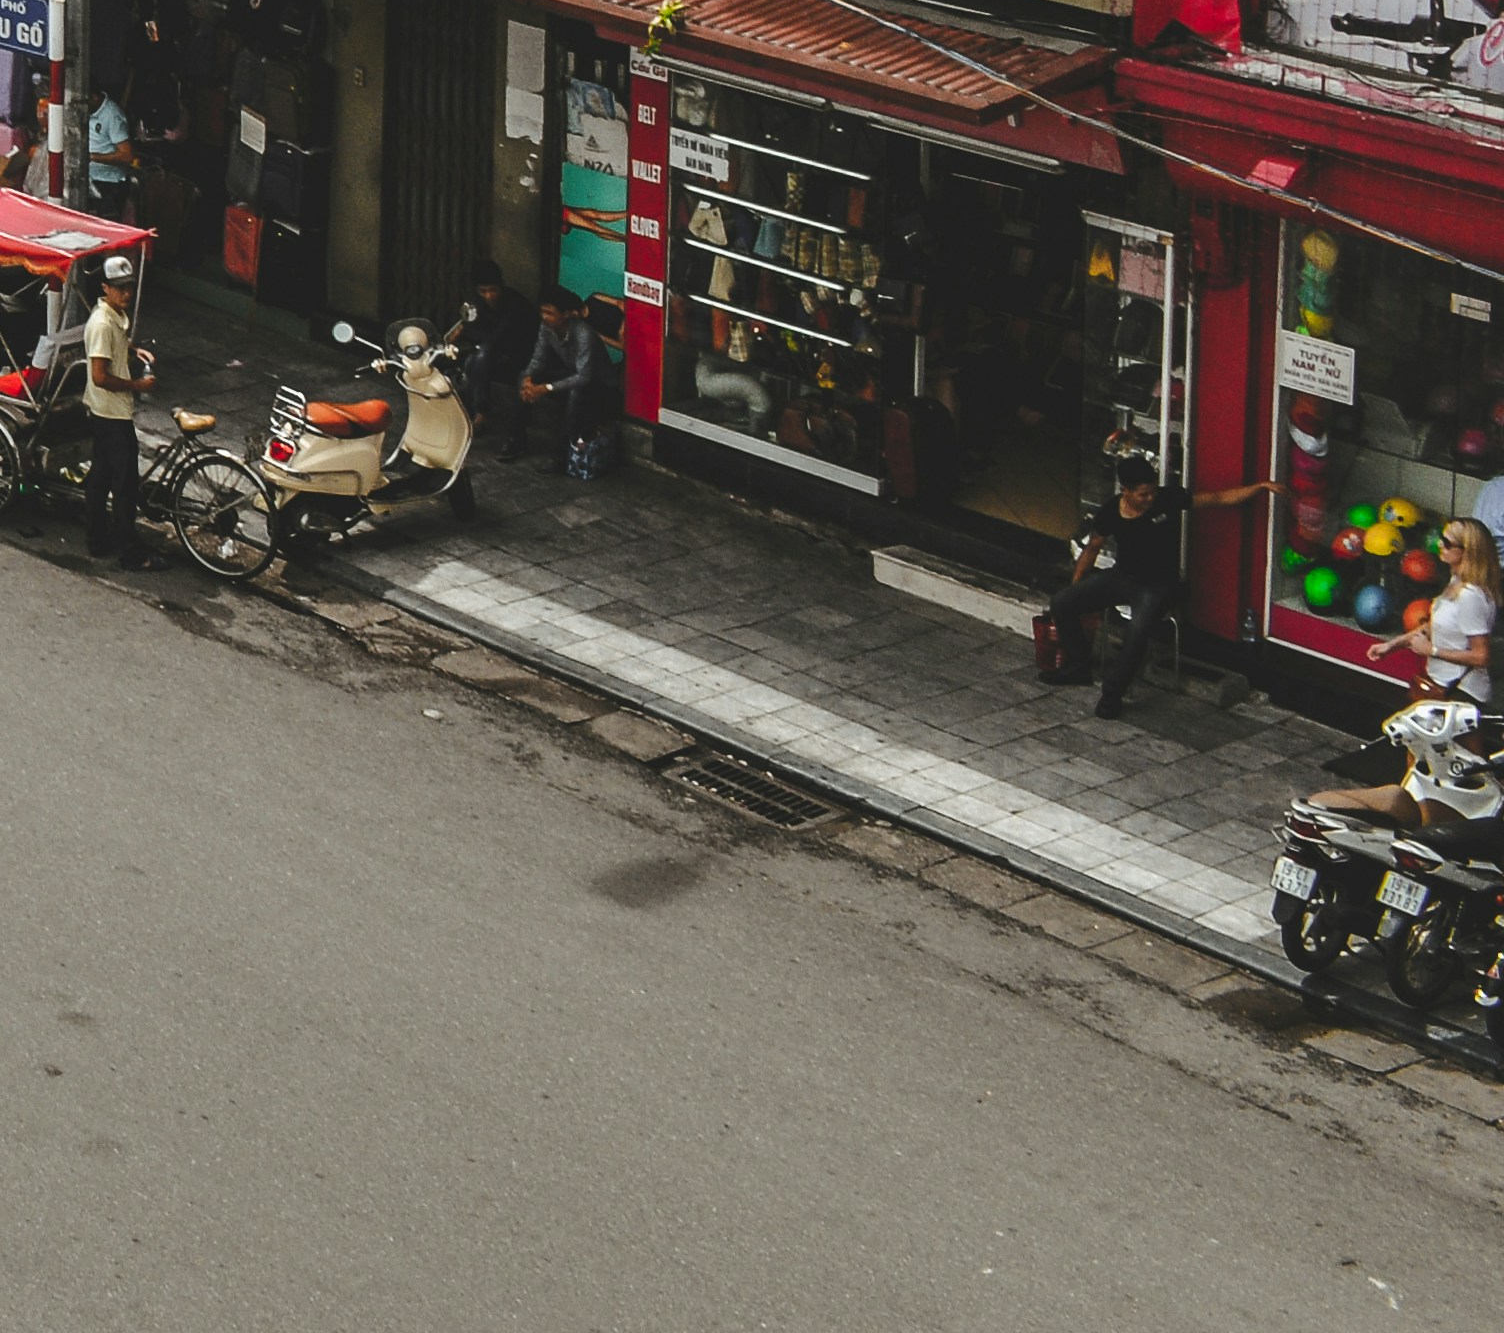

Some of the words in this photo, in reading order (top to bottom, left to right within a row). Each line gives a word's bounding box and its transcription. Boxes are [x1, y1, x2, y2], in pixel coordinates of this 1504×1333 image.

[16, 18, 44, 48] GỖ
[637, 103, 657, 125] BELT
[631, 158, 661, 185] WALLET
[1292, 358, 1316, 372] NAM
[1299, 349, 1336, 367] TUYỂN
